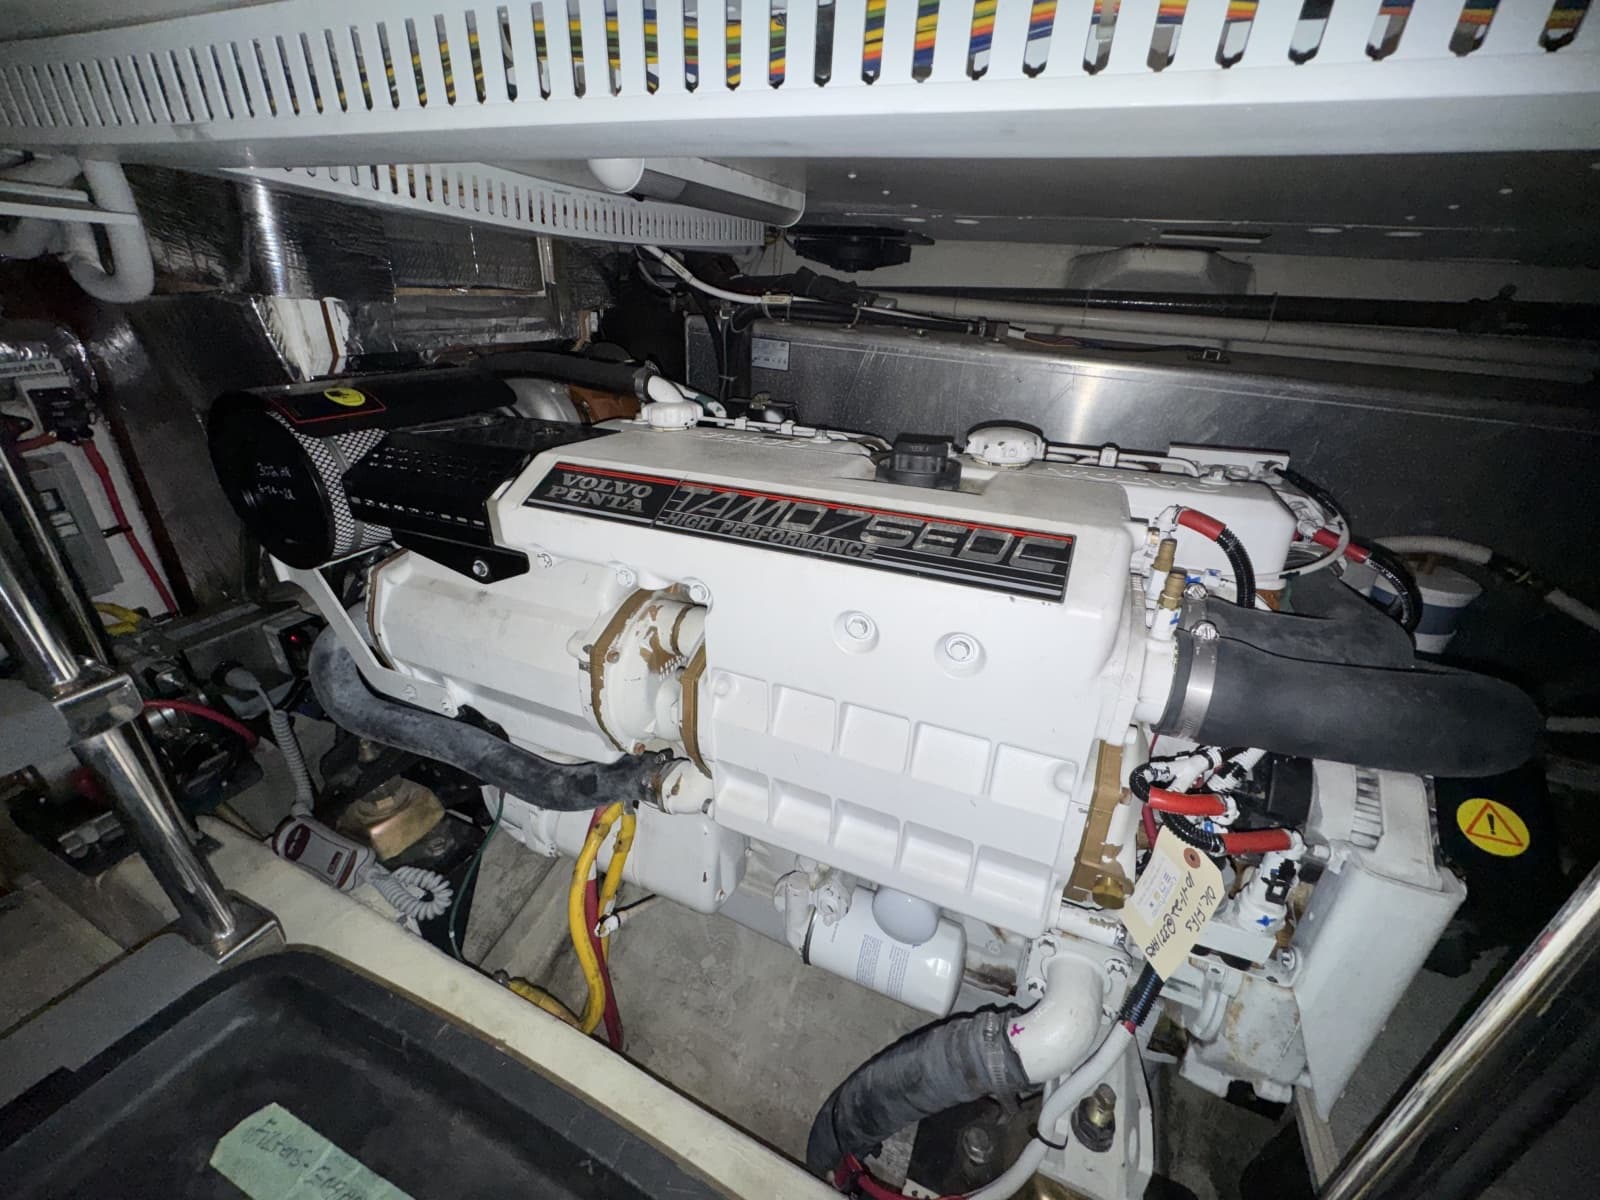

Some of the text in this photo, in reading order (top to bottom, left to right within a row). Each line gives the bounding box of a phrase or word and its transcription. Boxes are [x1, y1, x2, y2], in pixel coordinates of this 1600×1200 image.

[545, 485, 644, 513] PENTA
[562, 473, 653, 498] VOLVO
[664, 511, 880, 560] HIGH PERFORMANCE
